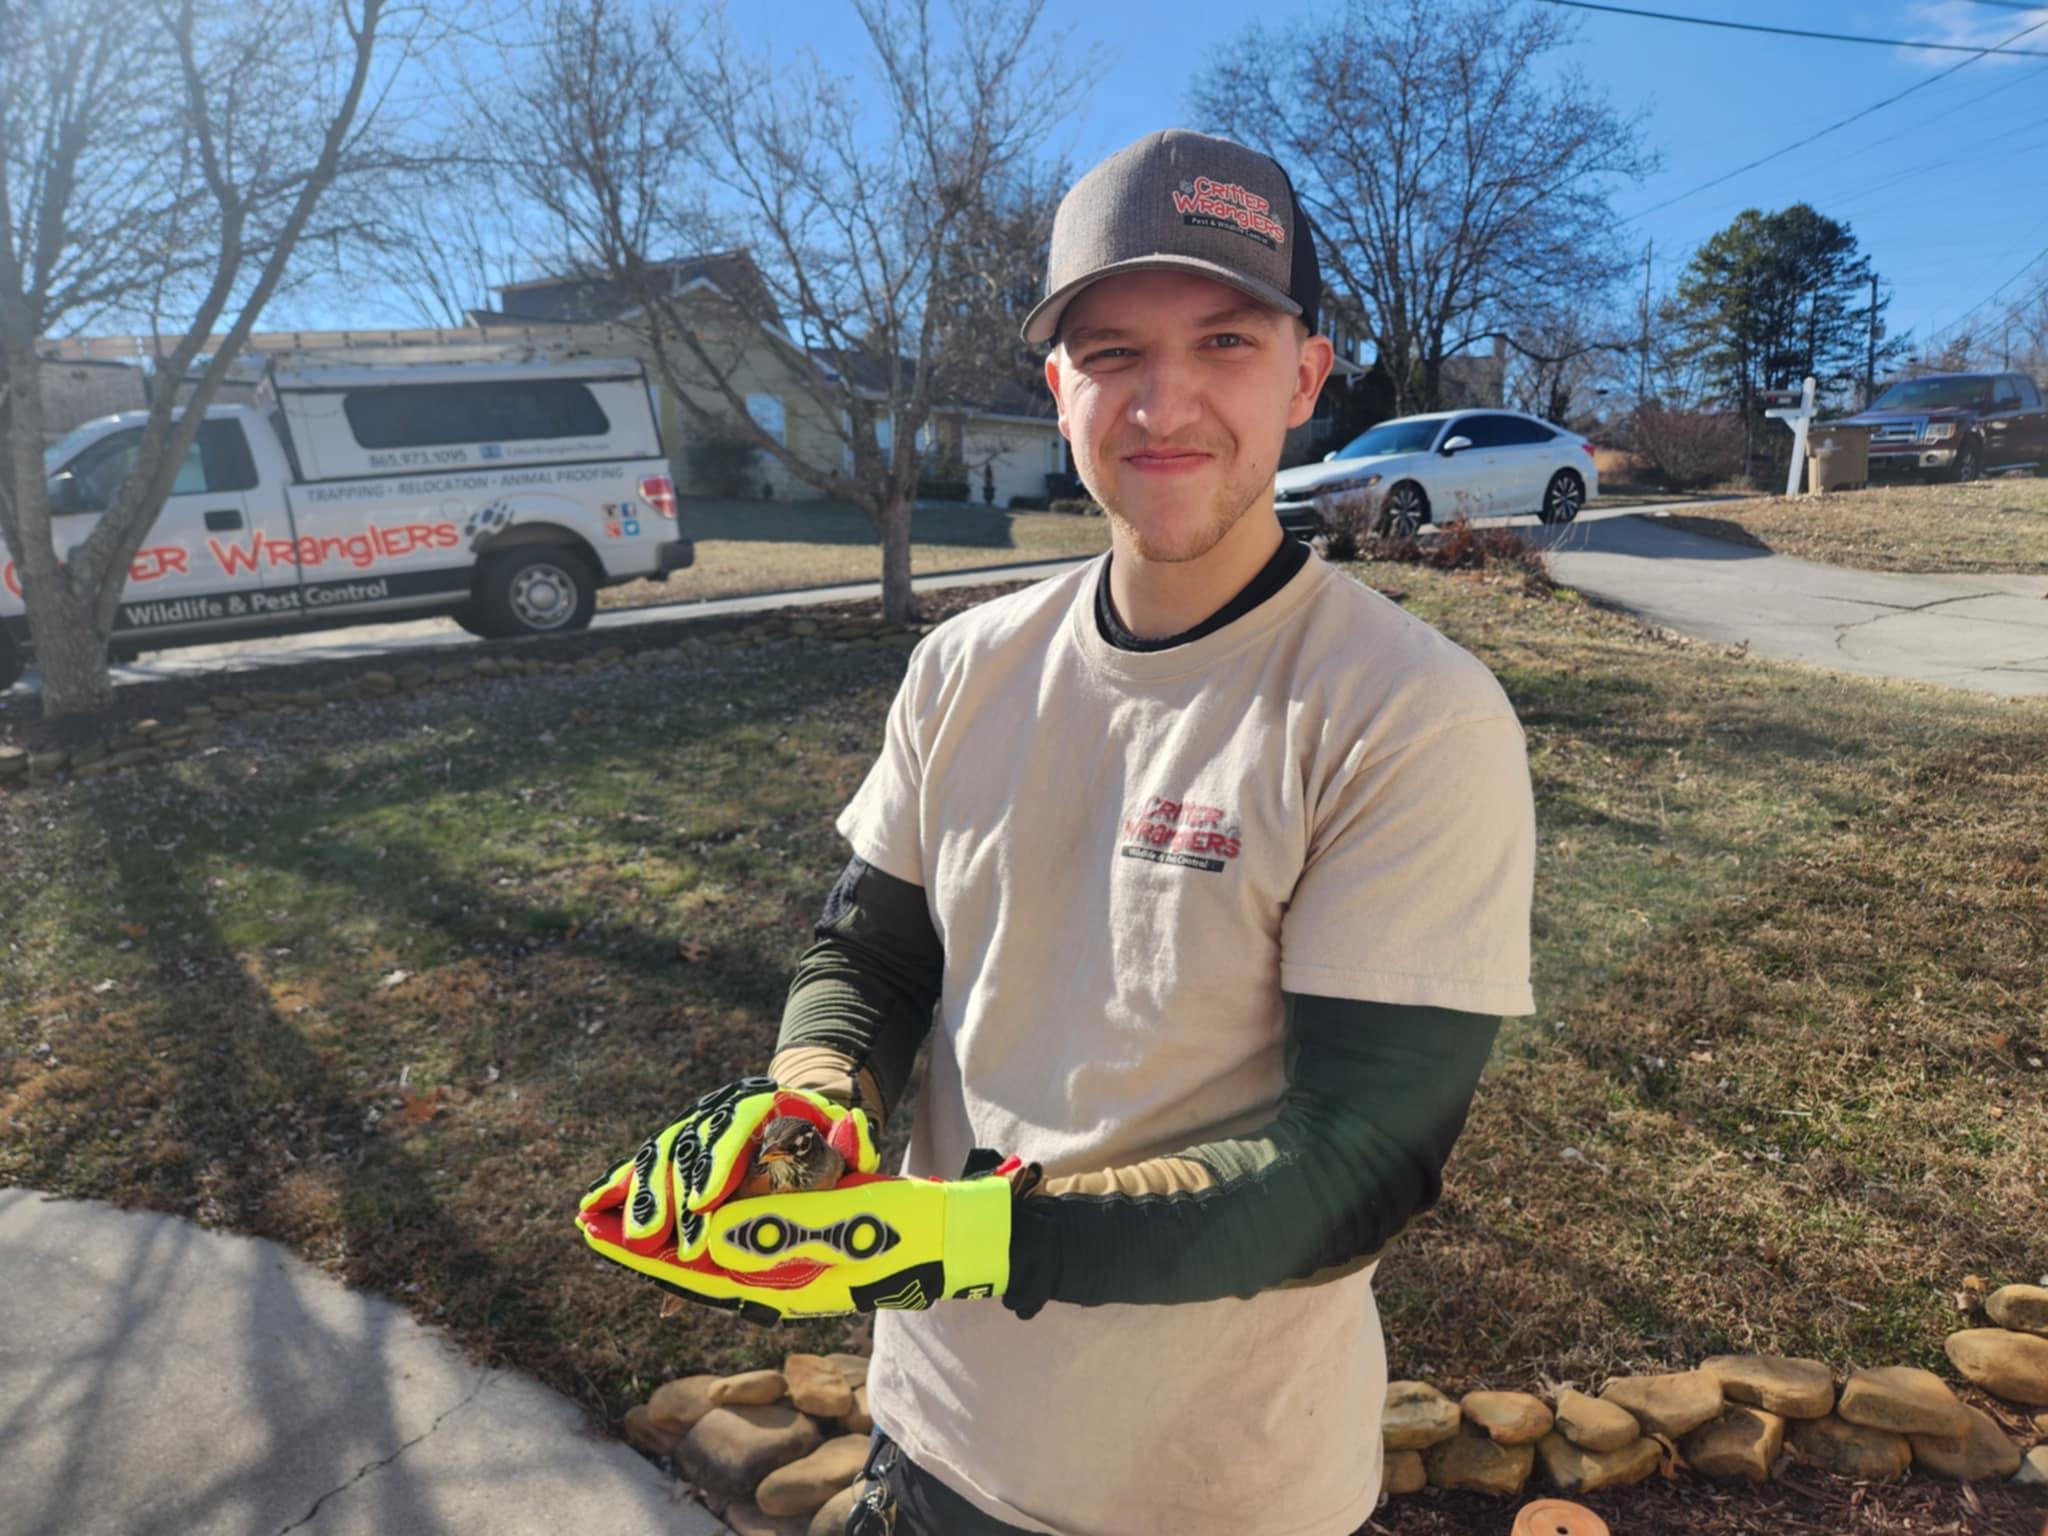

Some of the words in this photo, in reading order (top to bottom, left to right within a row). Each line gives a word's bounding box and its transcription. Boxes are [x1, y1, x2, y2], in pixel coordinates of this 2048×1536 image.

[307, 484, 385, 502] TRAPPING
[398, 475, 489, 495] RELOCATION
[500, 470, 553, 488] ANIMAL
[556, 466, 625, 483] PROOFING
[126, 599, 223, 626] Wildlife
[228, 595, 247, 614] &
[254, 590, 300, 611] Pest
[304, 579, 389, 605] Control
